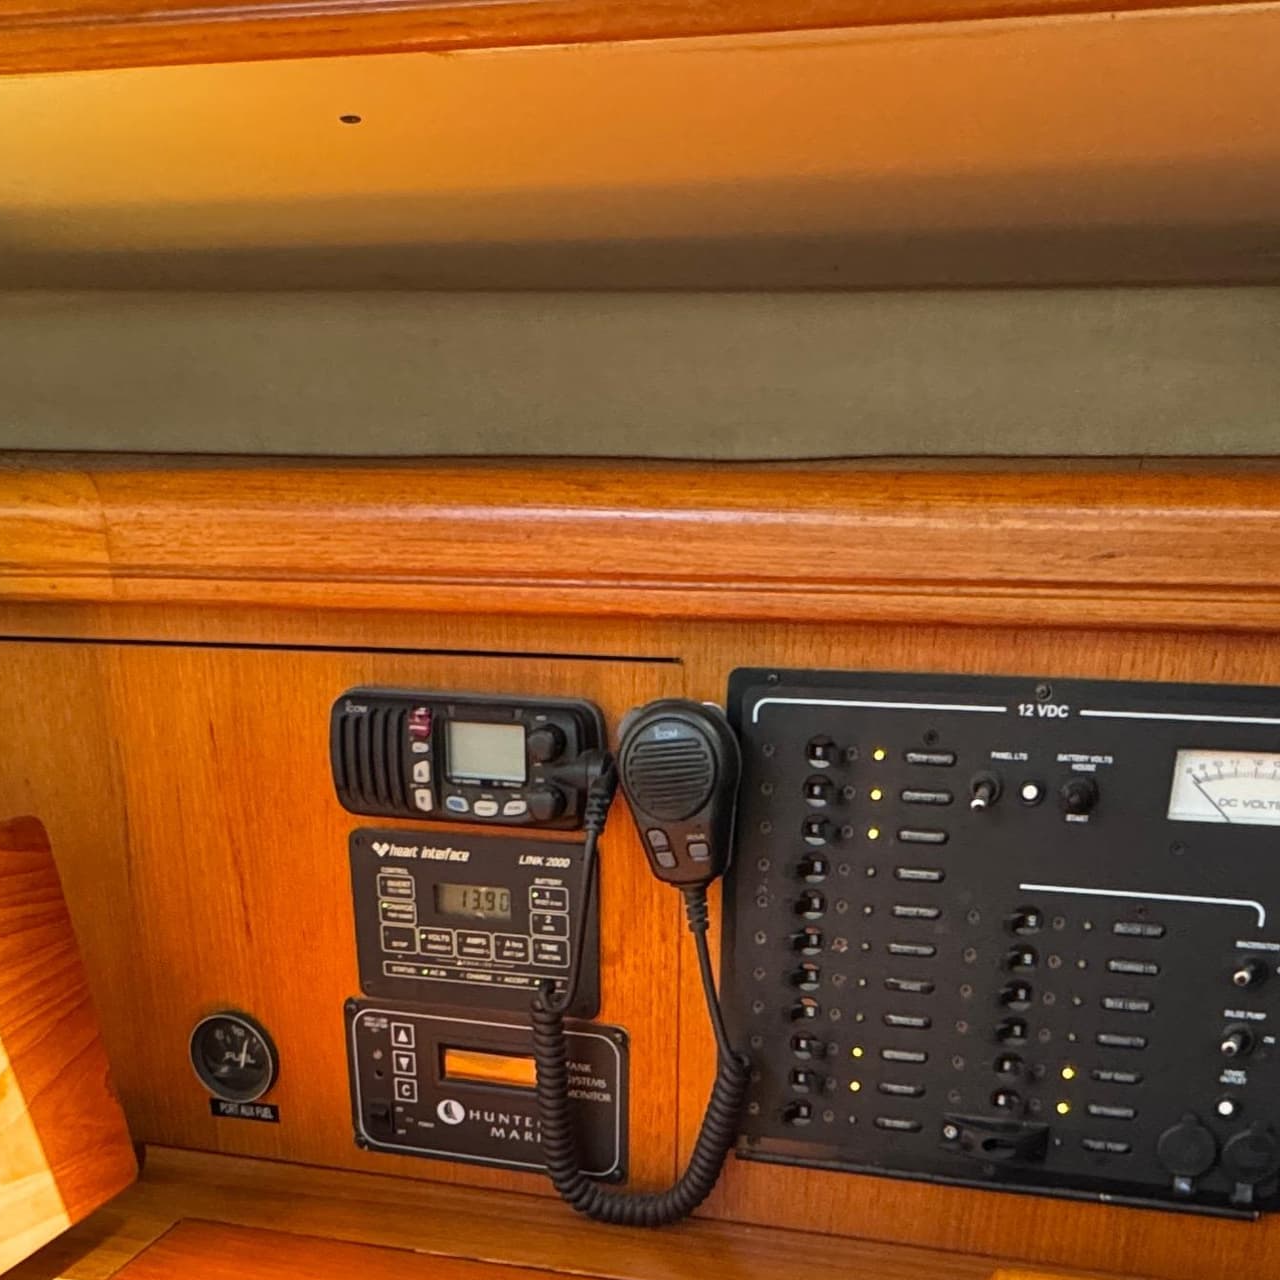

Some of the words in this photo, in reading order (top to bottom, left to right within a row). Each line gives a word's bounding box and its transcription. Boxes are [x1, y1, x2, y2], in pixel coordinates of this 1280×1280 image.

[1018, 704, 1034, 717] 12
[1037, 704, 1069, 718] VDC
[1057, 754, 1089, 763] BATTERY
[1090, 755, 1113, 764] VOLTS
[1219, 798, 1238, 808] DC
[389, 844, 418, 858] heart
[421, 846, 470, 862] interface
[519, 854, 544, 866] LINK
[545, 857, 570, 868] 2000
[461, 890, 510, 913] 13.90
[545, 915, 552, 924] 2
[401, 1084, 411, 1097] C
